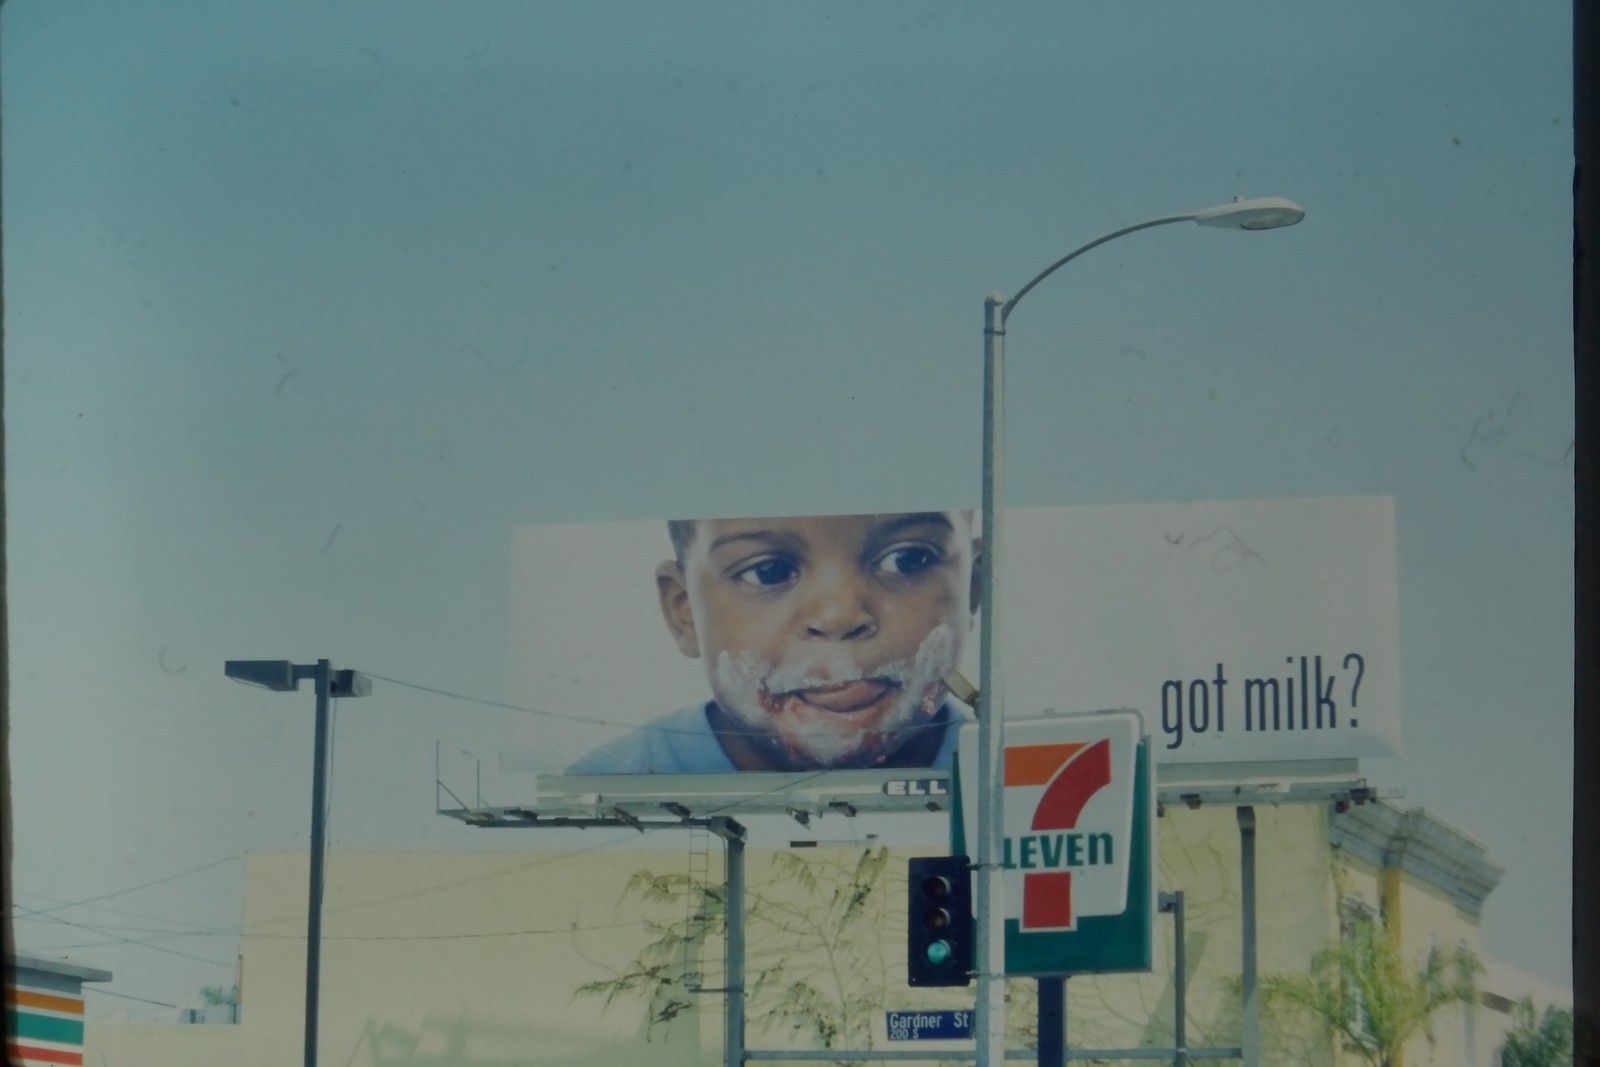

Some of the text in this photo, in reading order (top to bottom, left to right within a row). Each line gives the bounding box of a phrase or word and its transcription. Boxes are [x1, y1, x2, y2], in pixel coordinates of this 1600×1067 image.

[1162, 653, 1365, 749] got milk?
[1004, 738, 1111, 929] 7
[890, 1012, 969, 1029] Gardner St
[890, 1028, 919, 1039] 200 S
